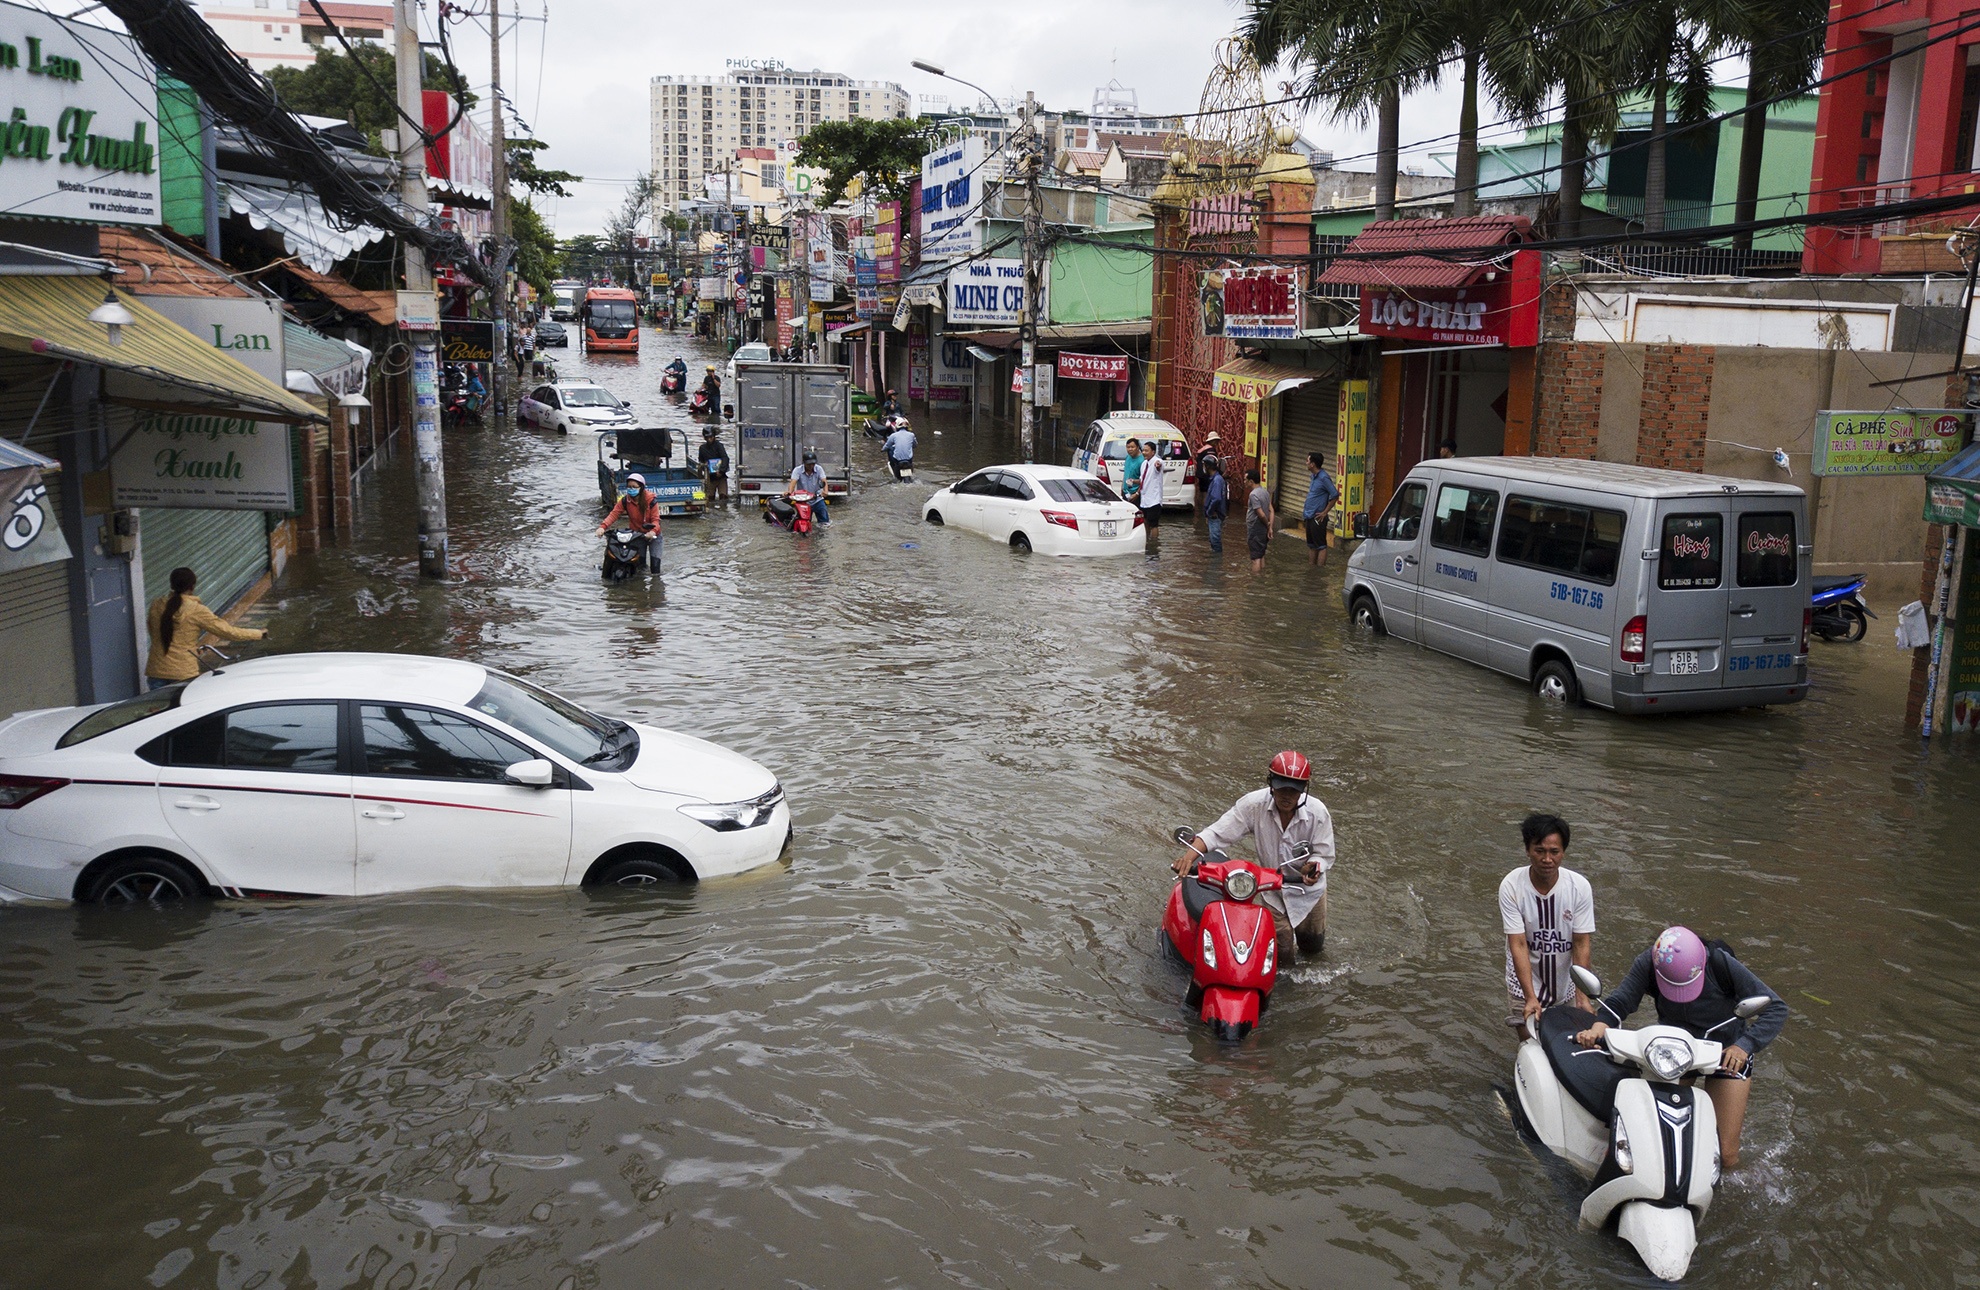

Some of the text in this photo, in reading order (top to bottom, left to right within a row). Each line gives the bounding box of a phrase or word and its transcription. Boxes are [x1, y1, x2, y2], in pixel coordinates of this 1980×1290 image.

[25, 36, 84, 82] Lan
[726, 56, 784, 69] PHÚC YÊN
[57, 179, 87, 193] Website:
[756, 225, 783, 235] Saigon
[751, 234, 787, 247] GYM
[970, 263, 992, 276] NHÀ
[954, 284, 999, 311] MINH
[1370, 290, 1487, 331] LỘC PHÁT
[210, 323, 272, 350] Lan
[1440, 333, 1454, 341] PHAN
[444, 341, 493, 360] Bolero
[1061, 356, 1126, 371] BỌC YÊN XE
[1220, 378, 1237, 397] BÒ
[1238, 381, 1254, 399] NÉ
[1351, 391, 1367, 412] SINH
[1835, 416, 1957, 438] CÀ PHÊ Sinh Tố 123
[154, 448, 245, 480] Xanh
[1673, 534, 1711, 559] Hùng
[1435, 562, 1442, 574] XE
[1442, 563, 1457, 578] TRUNG
[1550, 581, 1604, 610] 51B-167.56
[1676, 652, 1692, 662] 51B
[1729, 654, 1792, 671] 51B-167.56
[1671, 663, 1698, 673] 167.56
[1533, 930, 1567, 942] REAL
[1526, 941, 1573, 954] MADRID
